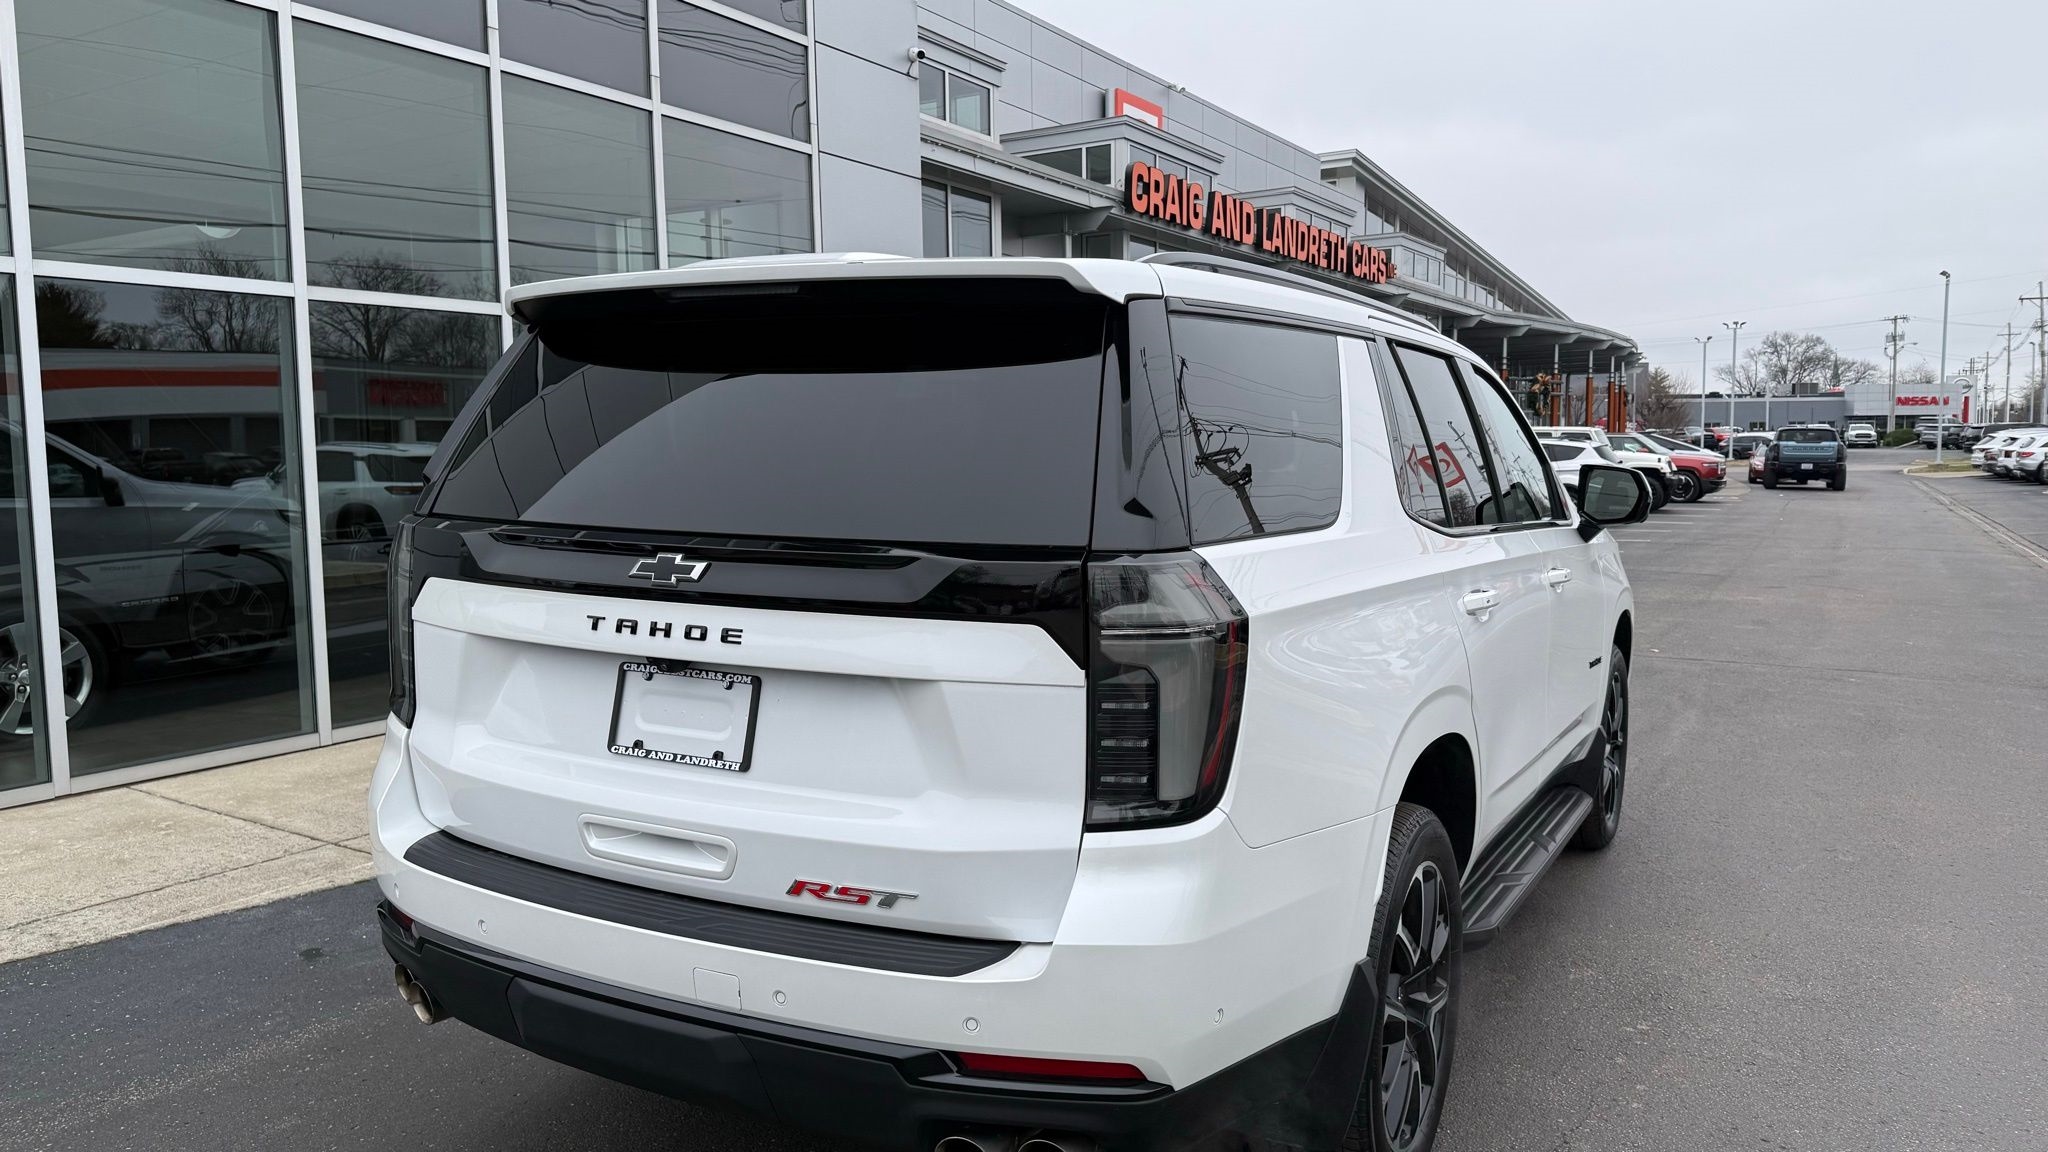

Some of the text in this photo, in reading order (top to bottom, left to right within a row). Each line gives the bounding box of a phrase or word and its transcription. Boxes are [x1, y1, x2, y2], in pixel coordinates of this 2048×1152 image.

[1130, 161, 1387, 285] CRAIG AND LANDRETH CARS
[1896, 396, 1950, 406] NISSAN
[586, 614, 744, 645] TAHOE
[623, 662, 753, 684] CRAIGSTCARS.COM
[610, 745, 741, 771] CRAIG AND LANDRETH
[785, 878, 920, 909] RST
